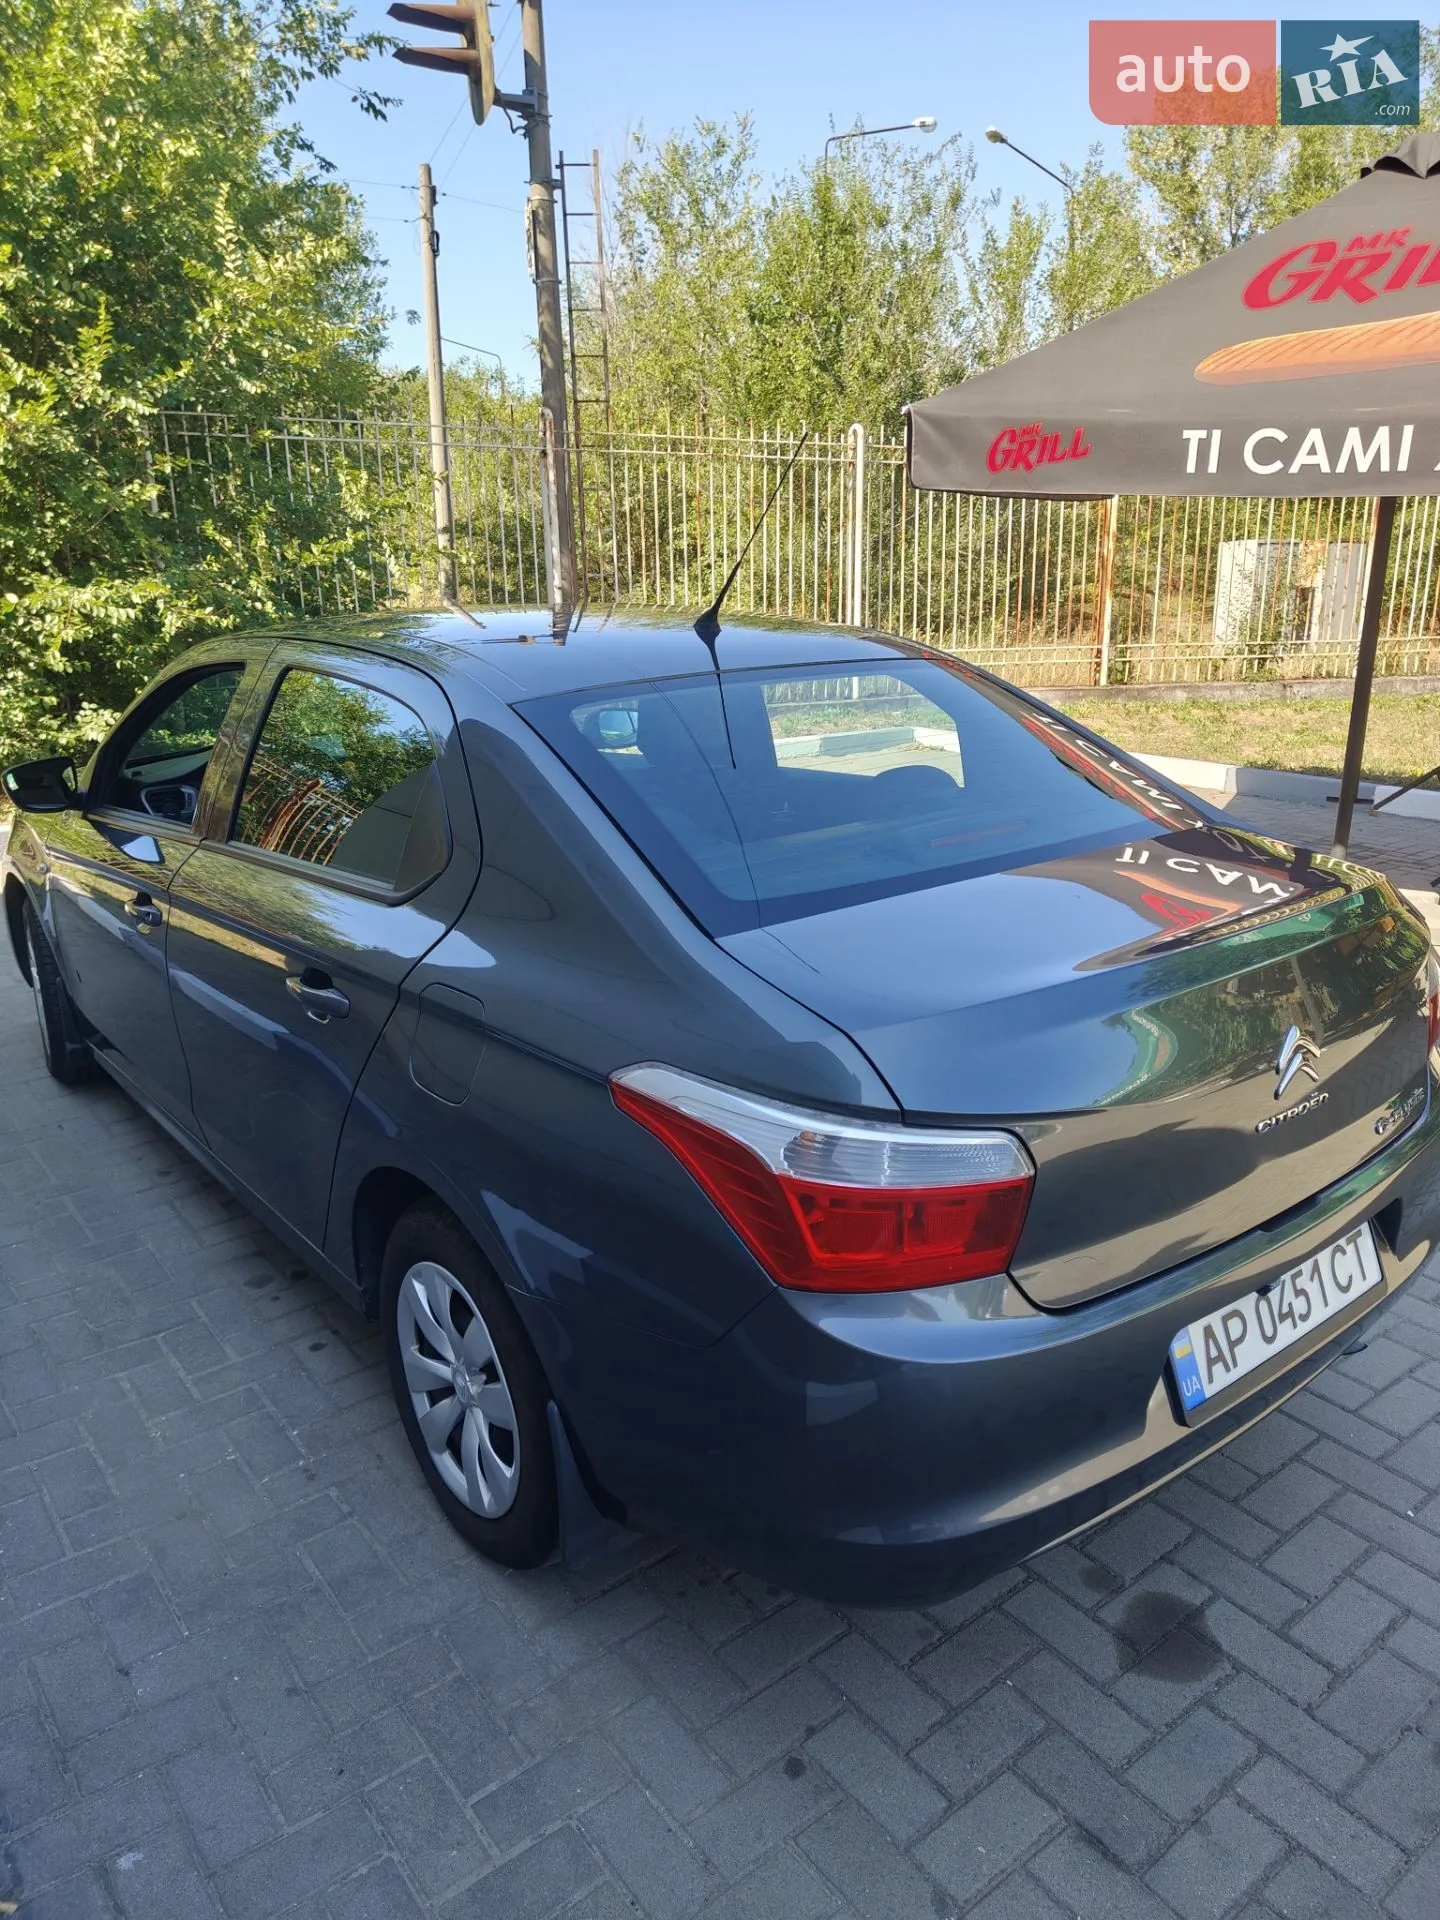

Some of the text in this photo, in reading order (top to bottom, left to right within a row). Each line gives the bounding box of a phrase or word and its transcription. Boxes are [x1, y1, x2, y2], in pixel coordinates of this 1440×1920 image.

[987, 427, 1092, 474] GRILL
[1182, 424, 1415, 475] TI CAMI
[1202, 1229, 1368, 1385] AP 0451 CT
[1181, 1375, 1201, 1397] UA
